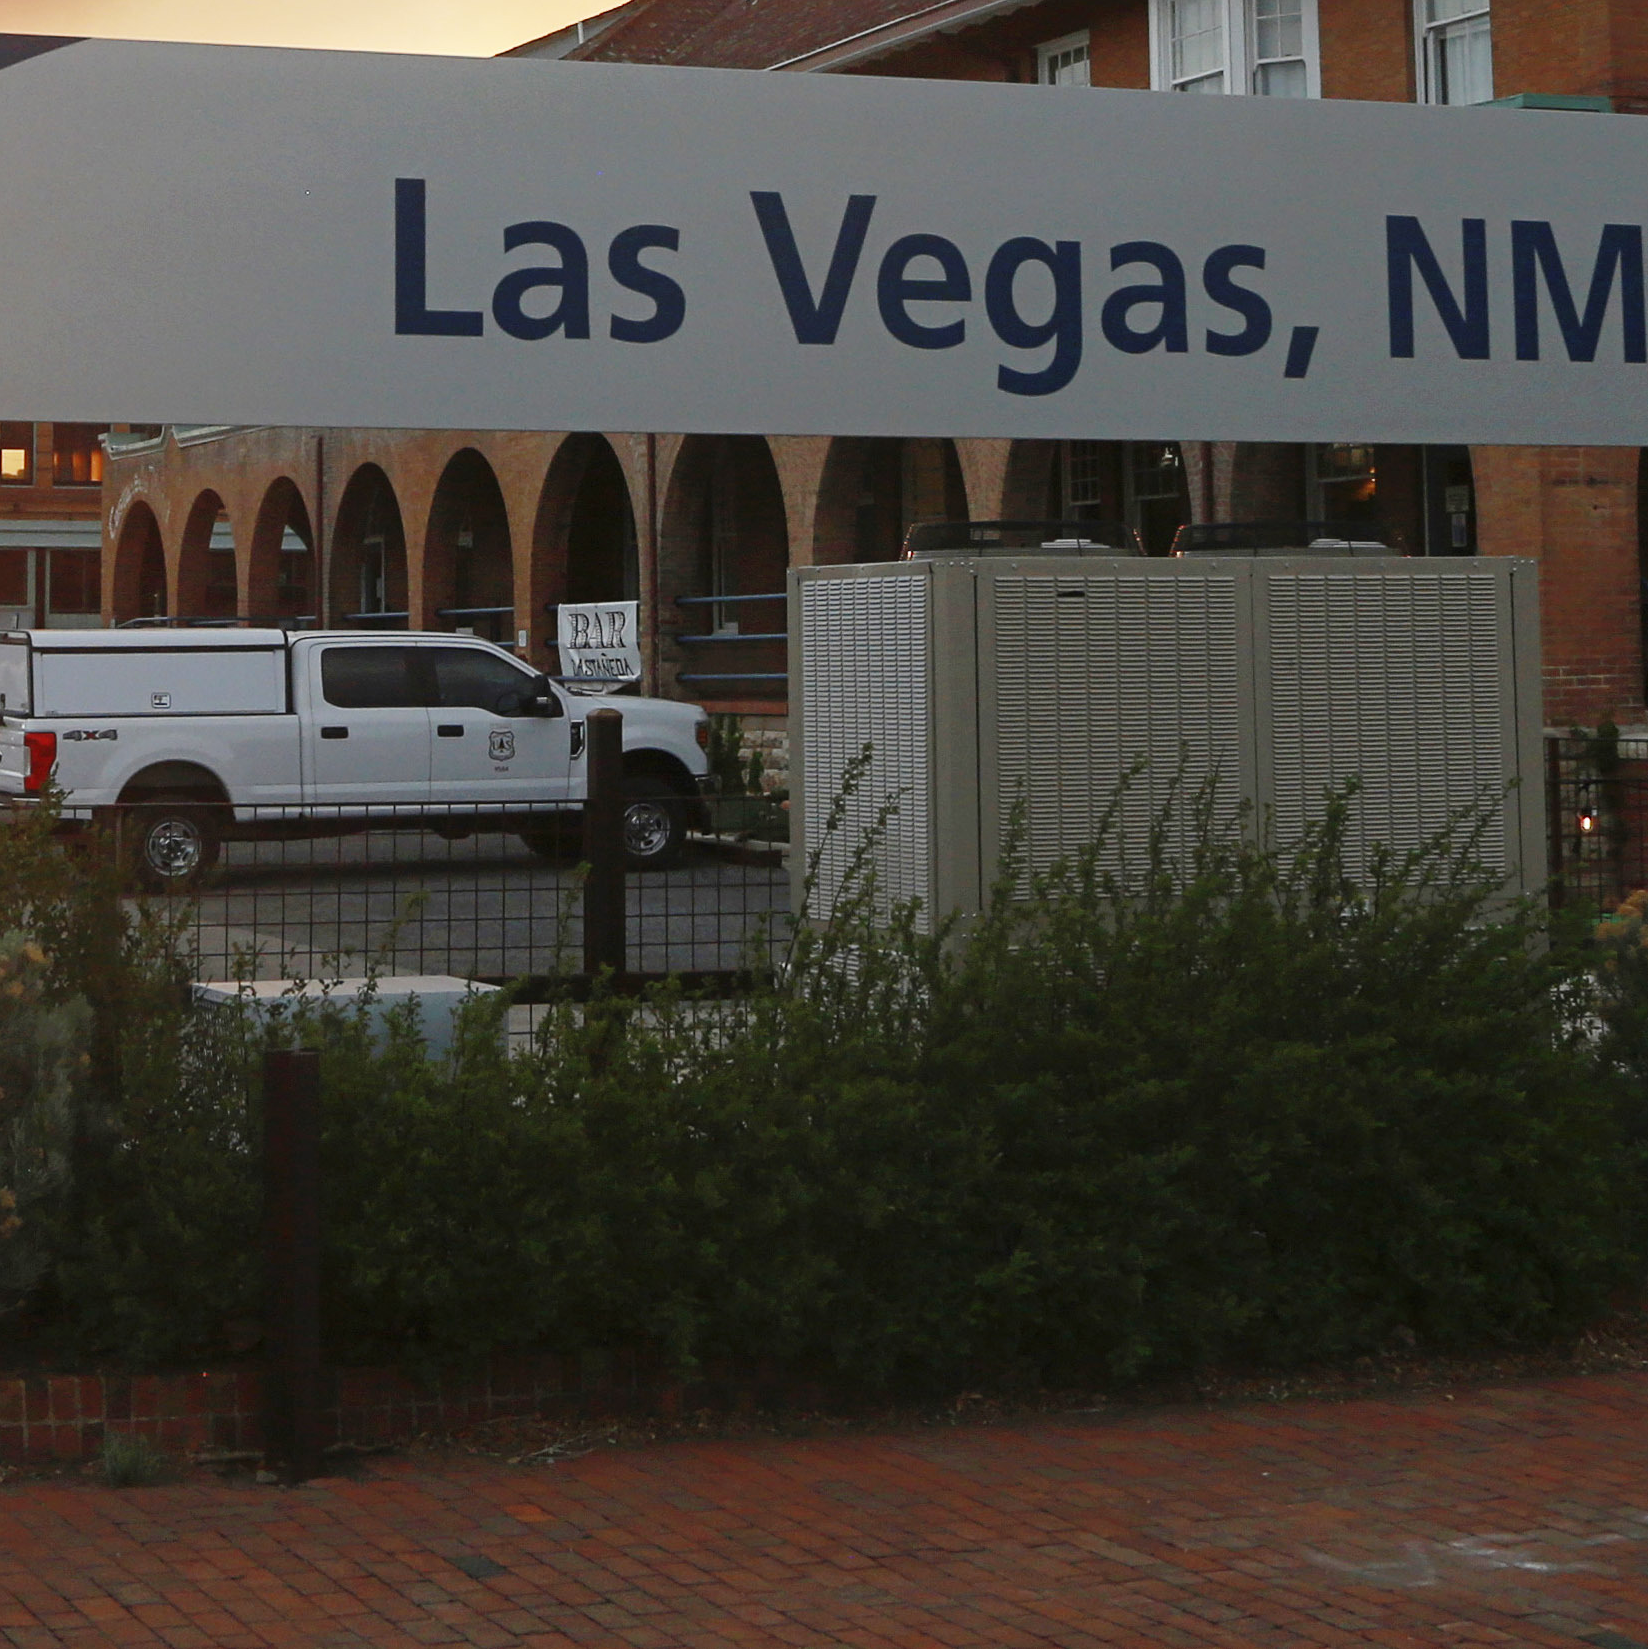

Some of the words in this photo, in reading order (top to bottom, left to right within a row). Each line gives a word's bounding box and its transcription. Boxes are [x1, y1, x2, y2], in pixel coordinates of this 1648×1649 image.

[394, 177, 686, 344] Las
[749, 190, 1320, 397] Vegas,
[1385, 214, 1648, 364] NM
[567, 612, 627, 649] BAR
